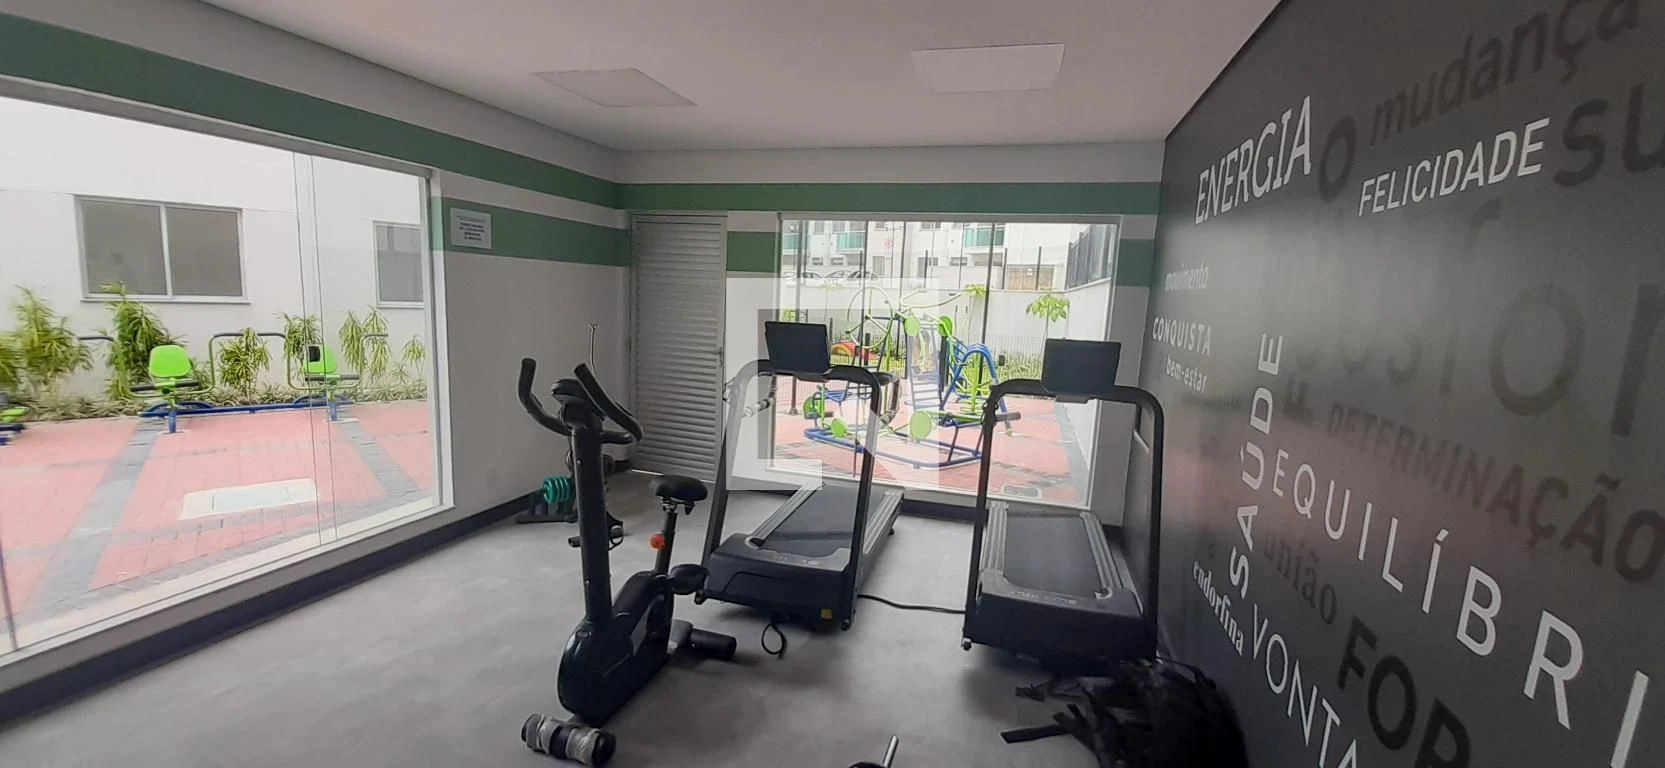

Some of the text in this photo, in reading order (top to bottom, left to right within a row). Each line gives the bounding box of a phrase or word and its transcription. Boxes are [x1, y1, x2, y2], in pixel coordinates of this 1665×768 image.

[1370, 0, 1641, 146] mudança
[1195, 95, 1311, 224] ENERGIA
[1358, 117, 1550, 217] FELICIDADE
[1152, 317, 1211, 357] CONQUISTA
[1166, 355, 1207, 394] bem-estar
[1229, 333, 1284, 599] SAÚDE
[1326, 400, 1665, 584] DETERMINAÇÃO
[1193, 560, 1244, 656] endorfina
